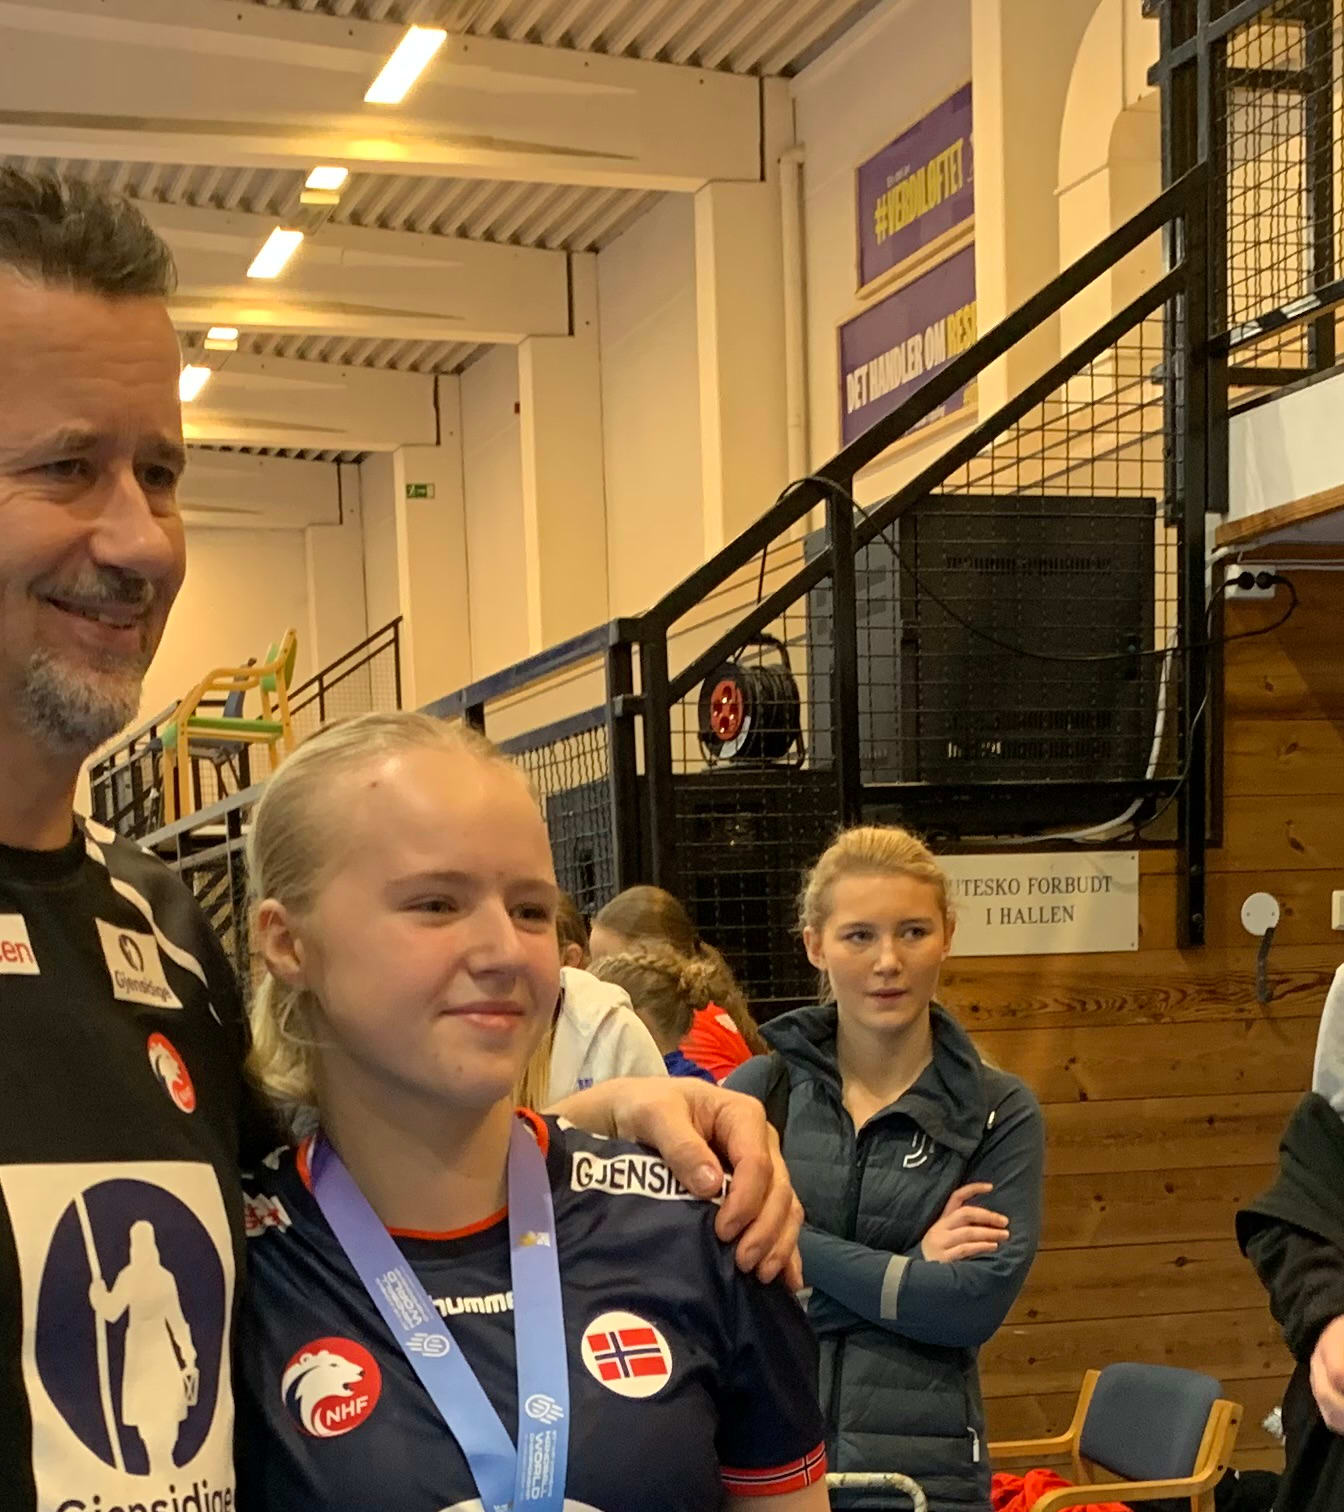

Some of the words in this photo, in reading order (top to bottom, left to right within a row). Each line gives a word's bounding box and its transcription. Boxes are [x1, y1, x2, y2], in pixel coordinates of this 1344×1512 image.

[846, 363, 869, 415] DET
[869, 332, 924, 402] HANDLER
[924, 317, 946, 371] OM
[947, 300, 977, 358] RES
[1028, 876, 1113, 895] FORBUDT
[986, 908, 992, 925] I
[1000, 905, 1075, 925] HALLEN
[576, 1156, 708, 1196] GJENSI
[326, 1395, 369, 1427] NHF
